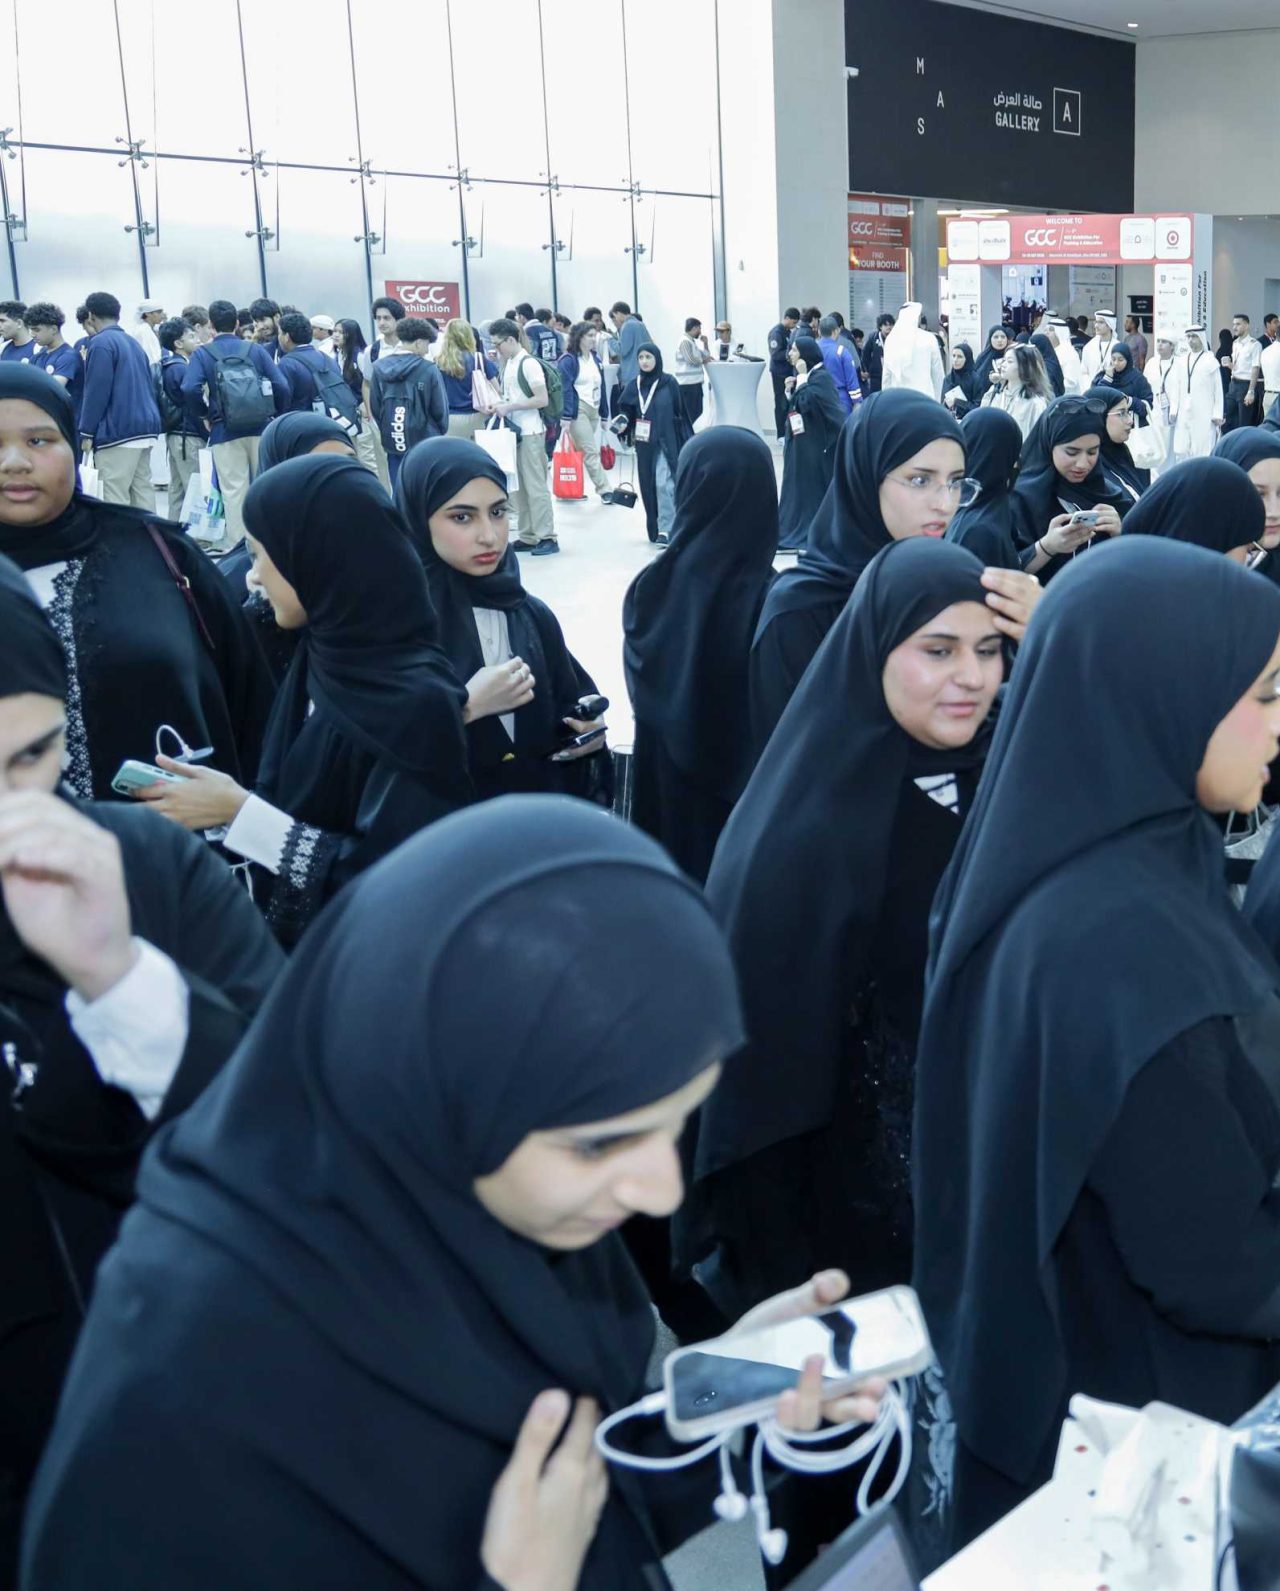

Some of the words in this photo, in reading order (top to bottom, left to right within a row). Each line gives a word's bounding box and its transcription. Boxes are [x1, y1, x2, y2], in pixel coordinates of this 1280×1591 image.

[916, 56, 925, 75] M
[936, 90, 945, 109] A
[993, 91, 1021, 108] العرض
[1022, 94, 1042, 110] صالة
[1062, 101, 1072, 123] A
[917, 117, 925, 135] S
[995, 111, 1040, 132] GALLERY
[850, 221, 873, 235] GCC
[1045, 217, 1074, 225] WELCOME
[1024, 229, 1057, 246] GCC
[877, 261, 900, 269] BOOTH
[400, 285, 447, 304] GCC
[404, 303, 450, 313] xhibition
[541, 338, 557, 360] 27
[391, 406, 406, 452] adidas
